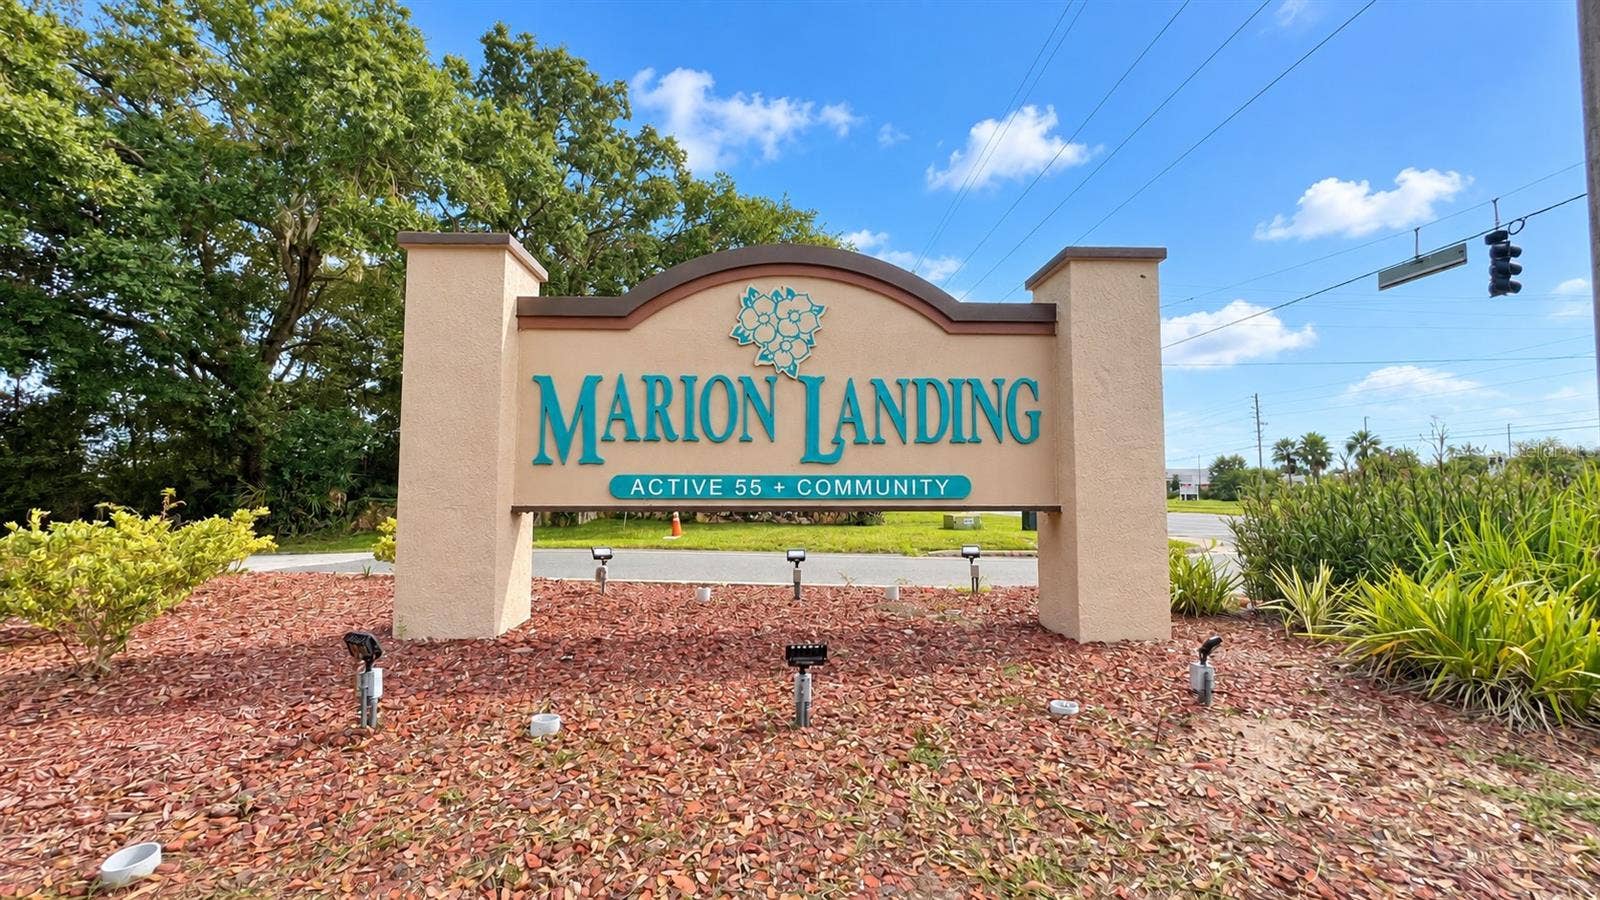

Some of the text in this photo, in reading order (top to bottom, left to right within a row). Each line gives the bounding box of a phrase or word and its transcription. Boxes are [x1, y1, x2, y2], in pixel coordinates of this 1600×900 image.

[532, 374, 1042, 466] MARION LANDING
[629, 478, 950, 496] ACTIVE 55 + COMMUNITY
